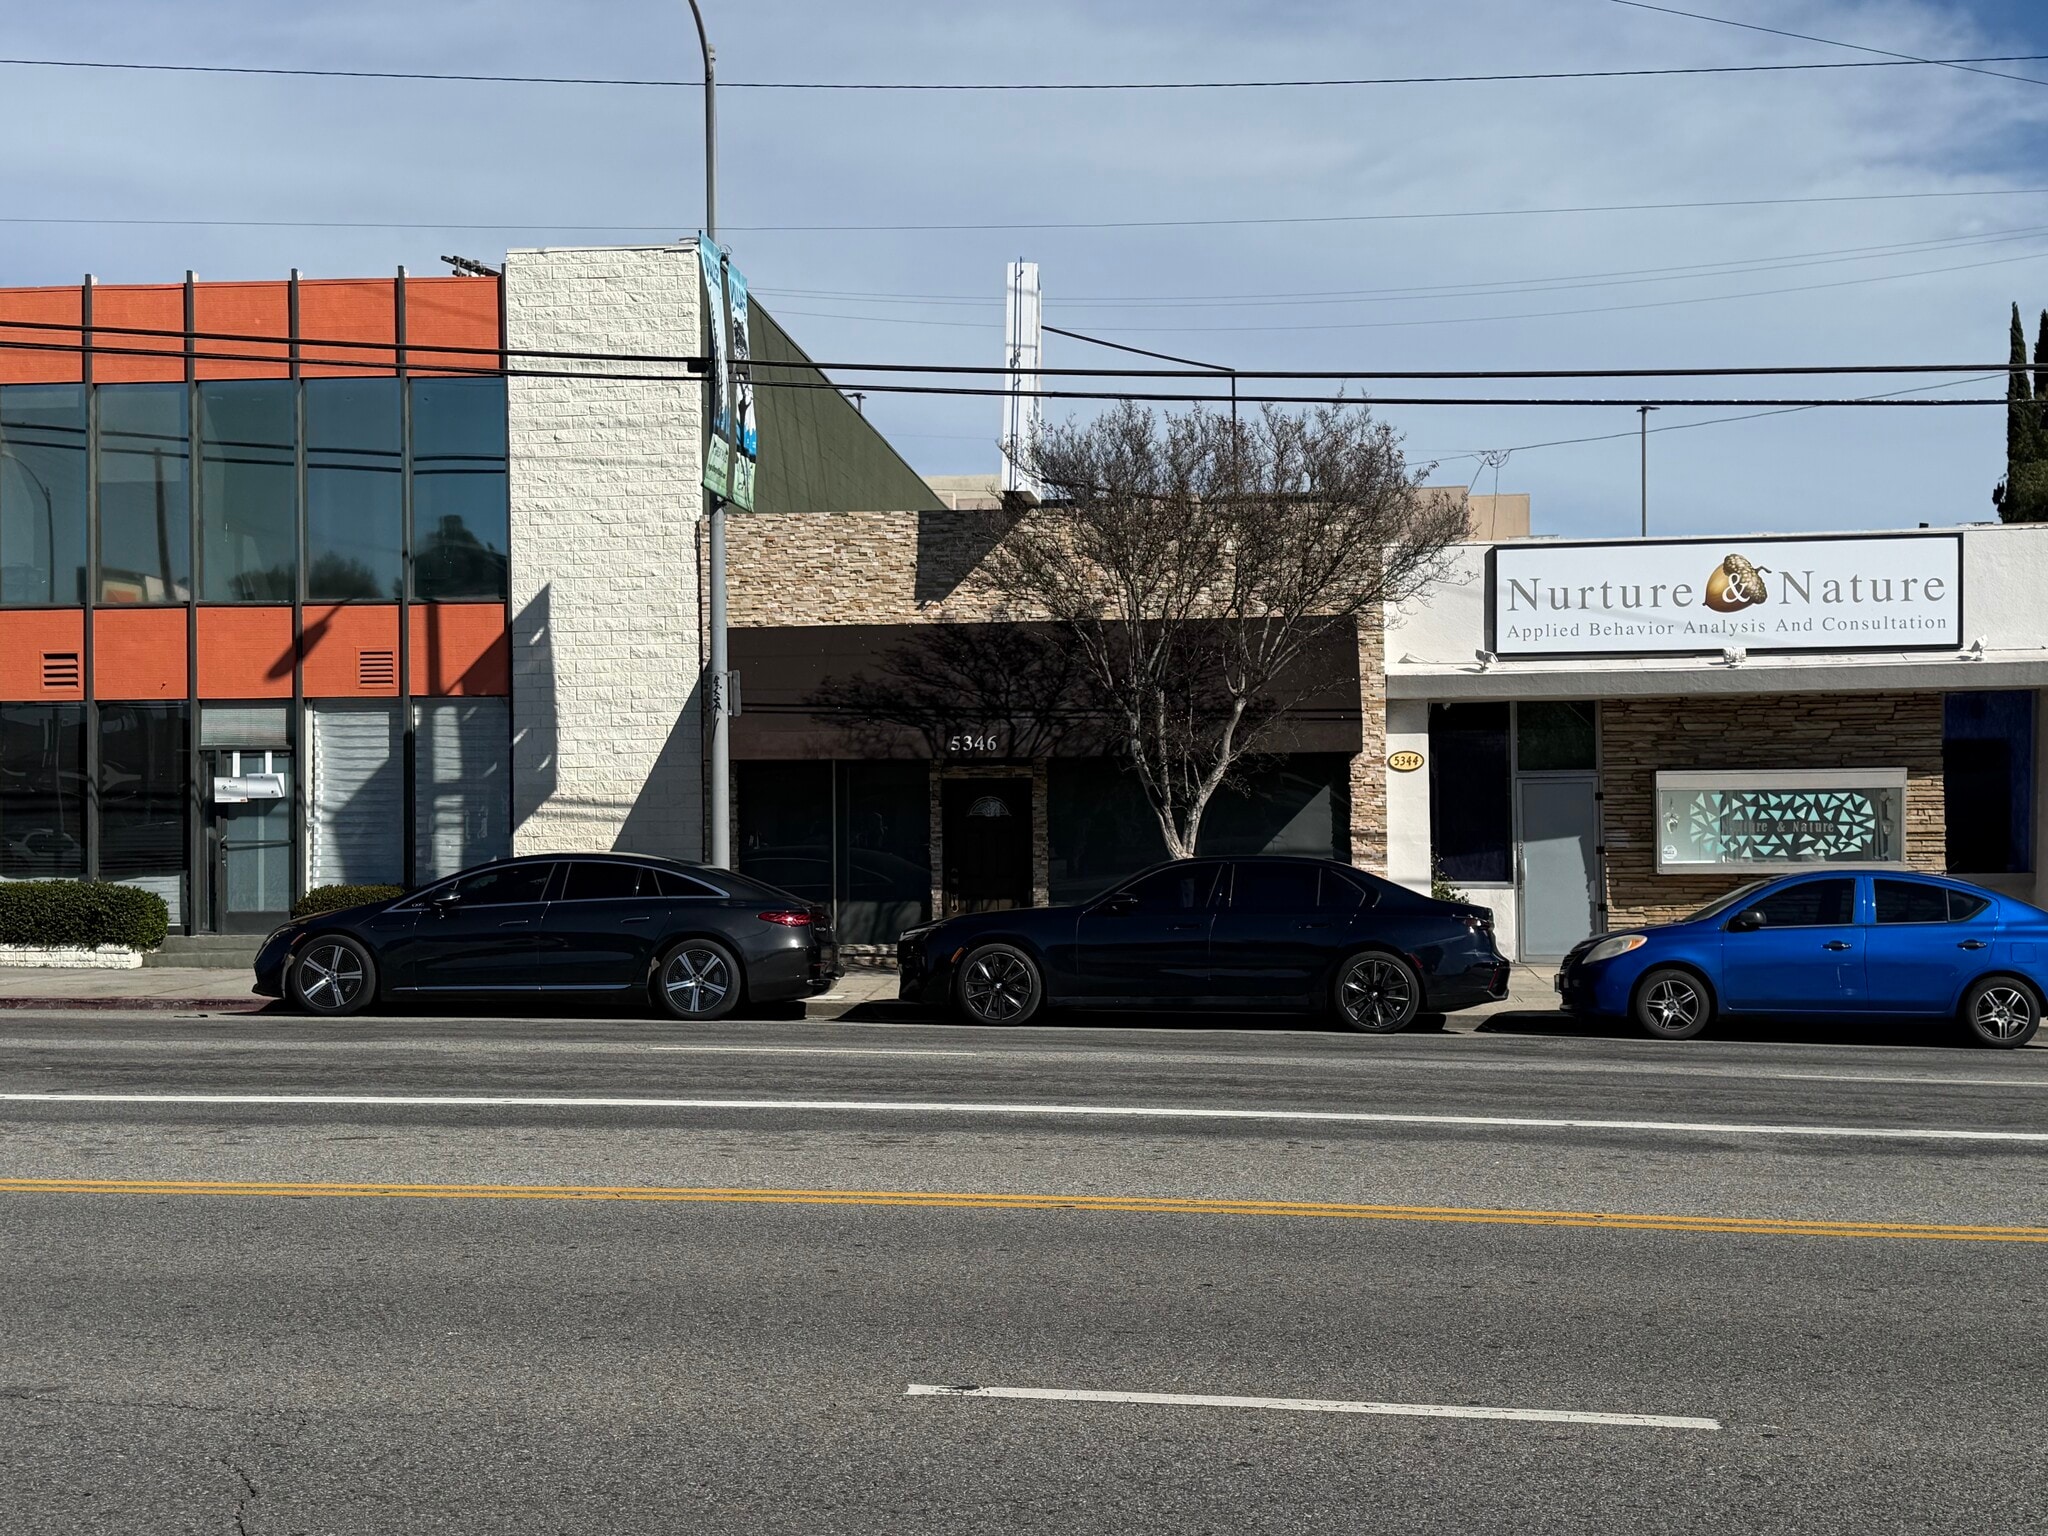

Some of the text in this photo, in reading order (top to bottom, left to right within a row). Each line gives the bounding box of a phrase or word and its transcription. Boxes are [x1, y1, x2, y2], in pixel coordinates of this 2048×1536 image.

[1507, 570, 1946, 612] Nurture & Nature
[1506, 615, 1947, 641] Applied Behavior Analysis And Consultation
[950, 735, 997, 751] 5346
[1394, 755, 1419, 766] 5344
[1777, 821, 1786, 832] &
[1792, 822, 1834, 833] Nature
